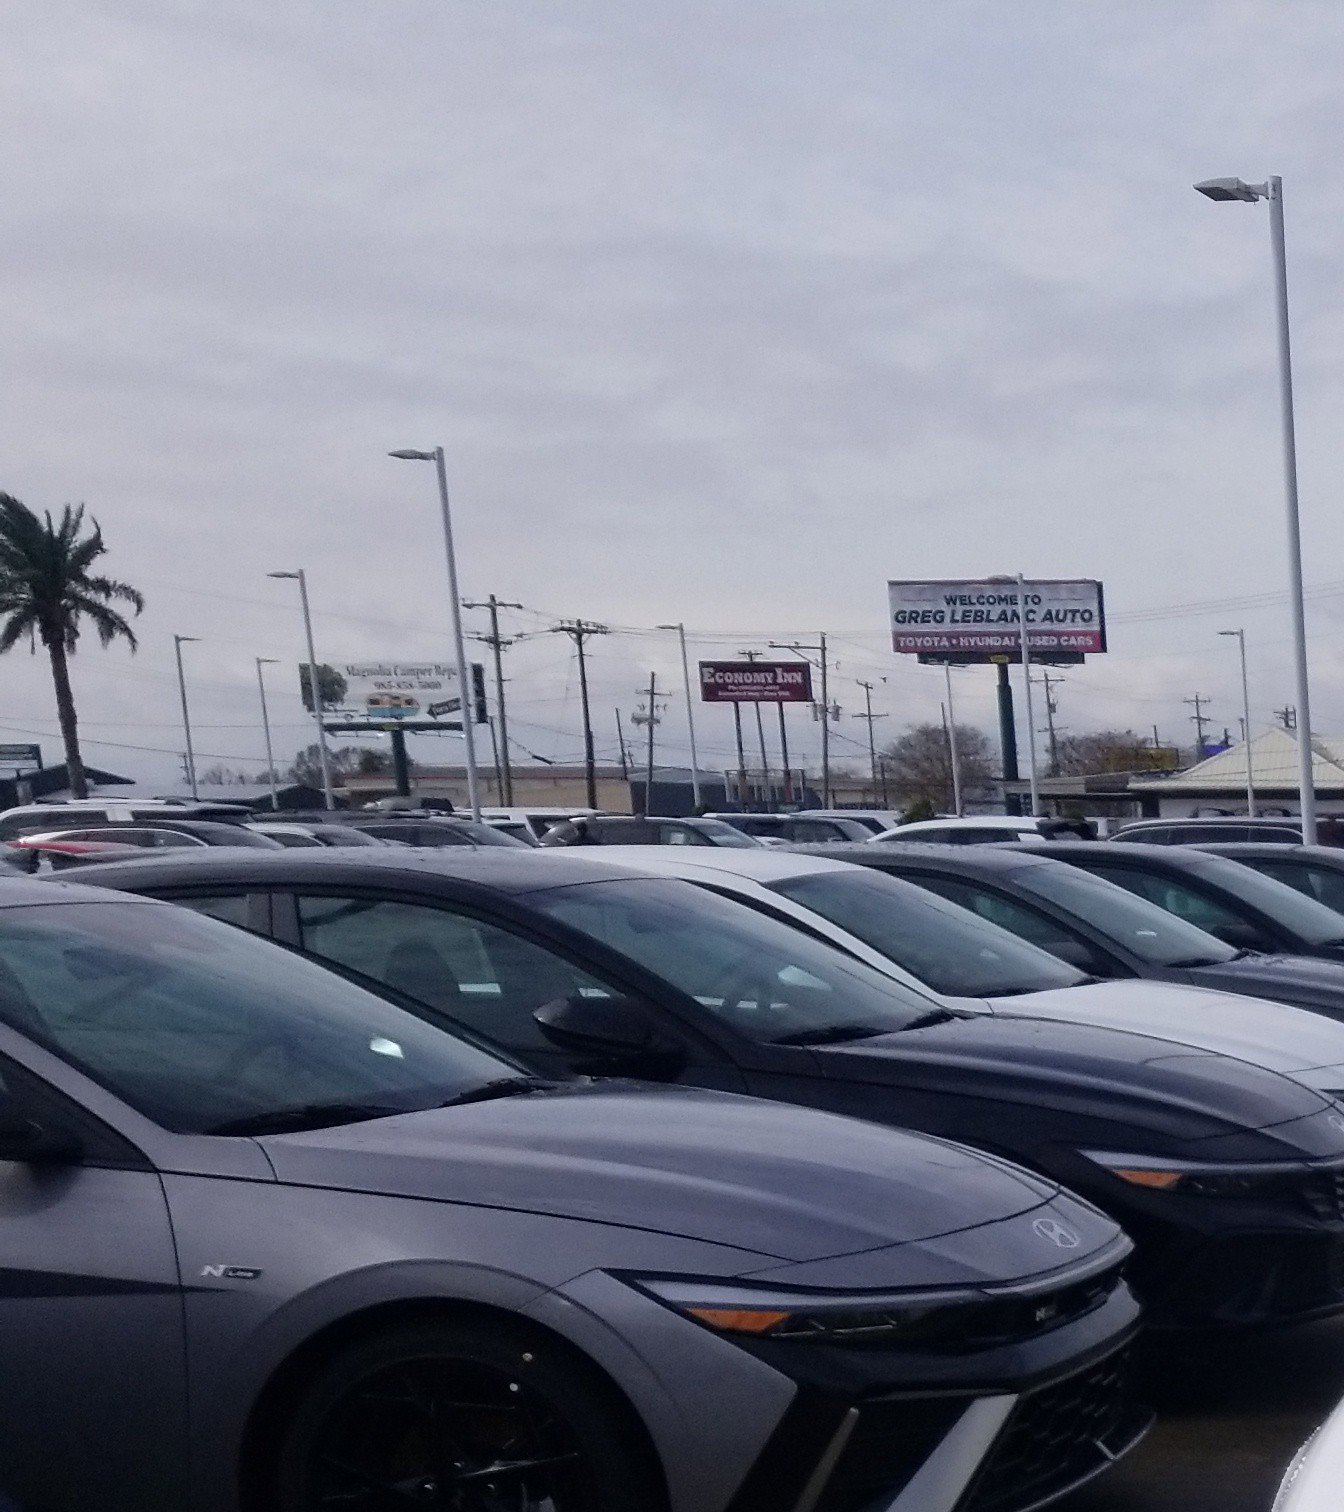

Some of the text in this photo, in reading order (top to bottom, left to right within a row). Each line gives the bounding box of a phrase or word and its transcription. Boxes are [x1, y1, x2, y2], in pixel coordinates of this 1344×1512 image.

[944, 594, 1042, 606] WELCOME TO
[894, 608, 1093, 624] GREG LEBLANC AUTO
[899, 636, 1094, 647] TOYOTA HYUNDAI USED CARS
[702, 667, 803, 684] ECONOMY INN
